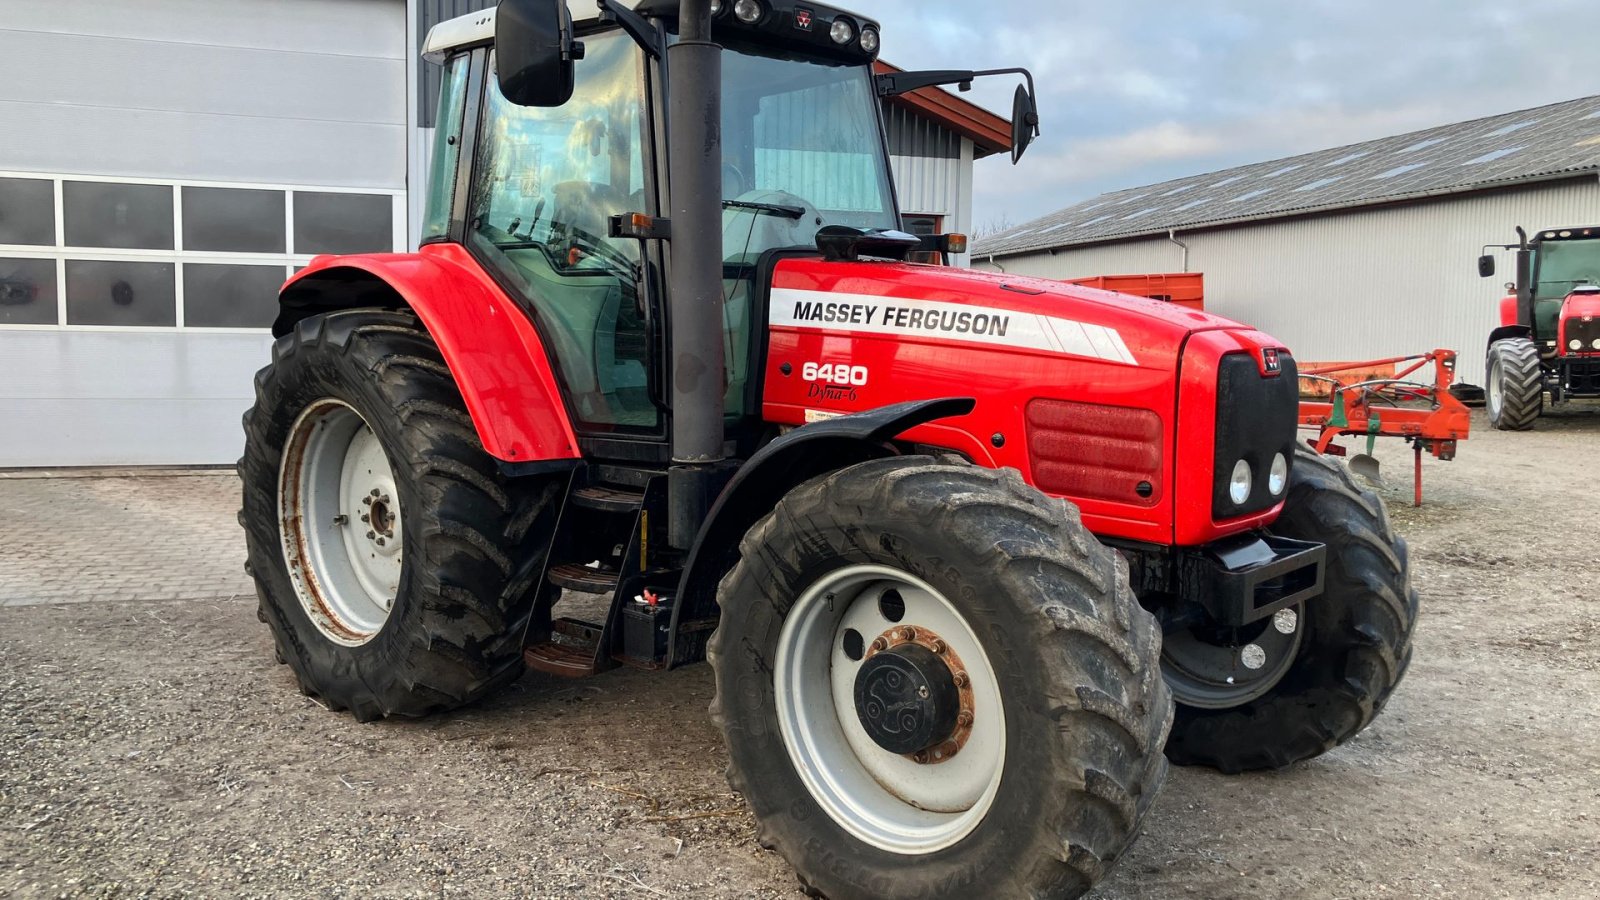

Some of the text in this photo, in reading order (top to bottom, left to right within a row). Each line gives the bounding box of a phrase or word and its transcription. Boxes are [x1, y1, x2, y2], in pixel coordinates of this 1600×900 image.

[793, 301, 1009, 336] MASSEY FERGUSON
[802, 362, 868, 385] 6480
[807, 383, 857, 402] Dyna-6
